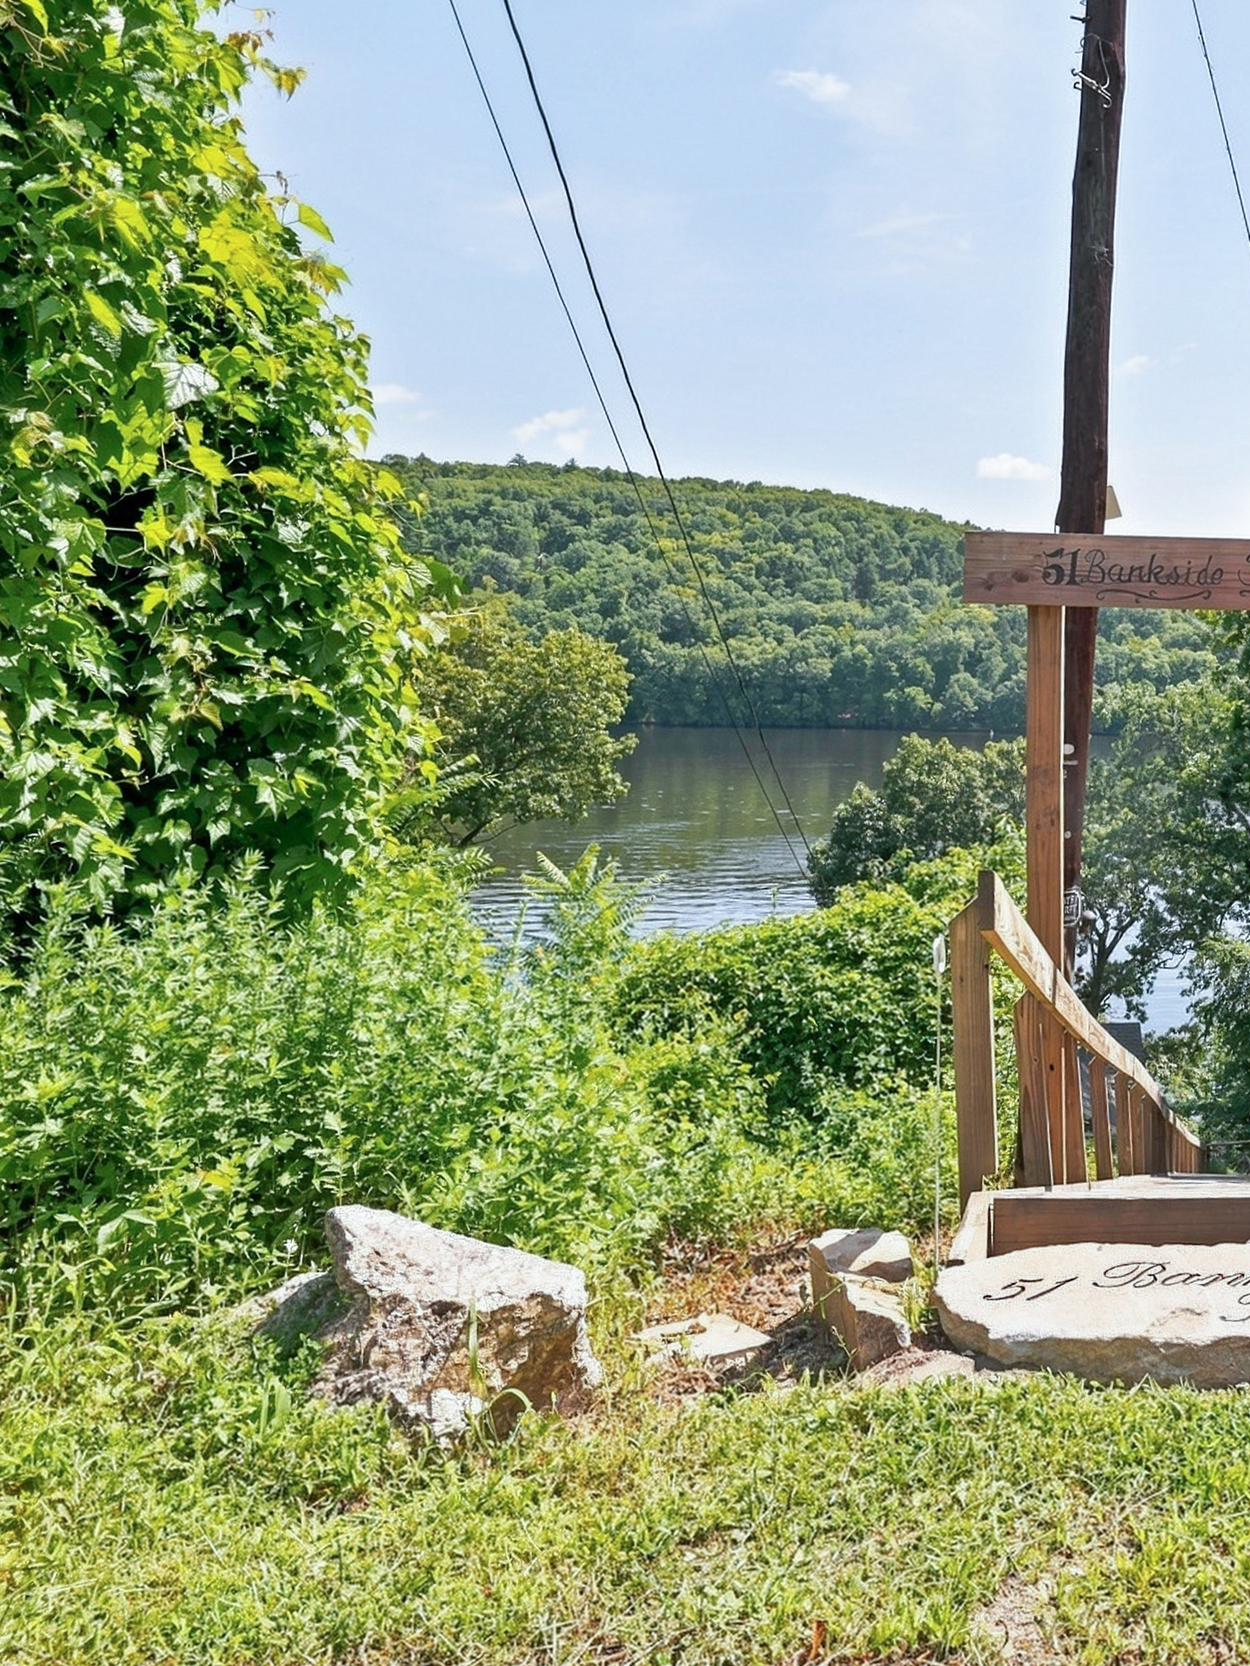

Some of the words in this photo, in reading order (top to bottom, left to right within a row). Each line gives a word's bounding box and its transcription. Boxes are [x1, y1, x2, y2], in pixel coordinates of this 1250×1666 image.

[1042, 548, 1080, 586] 51
[1082, 549, 1224, 585] Bankside
[983, 1276, 1079, 1301] 51
